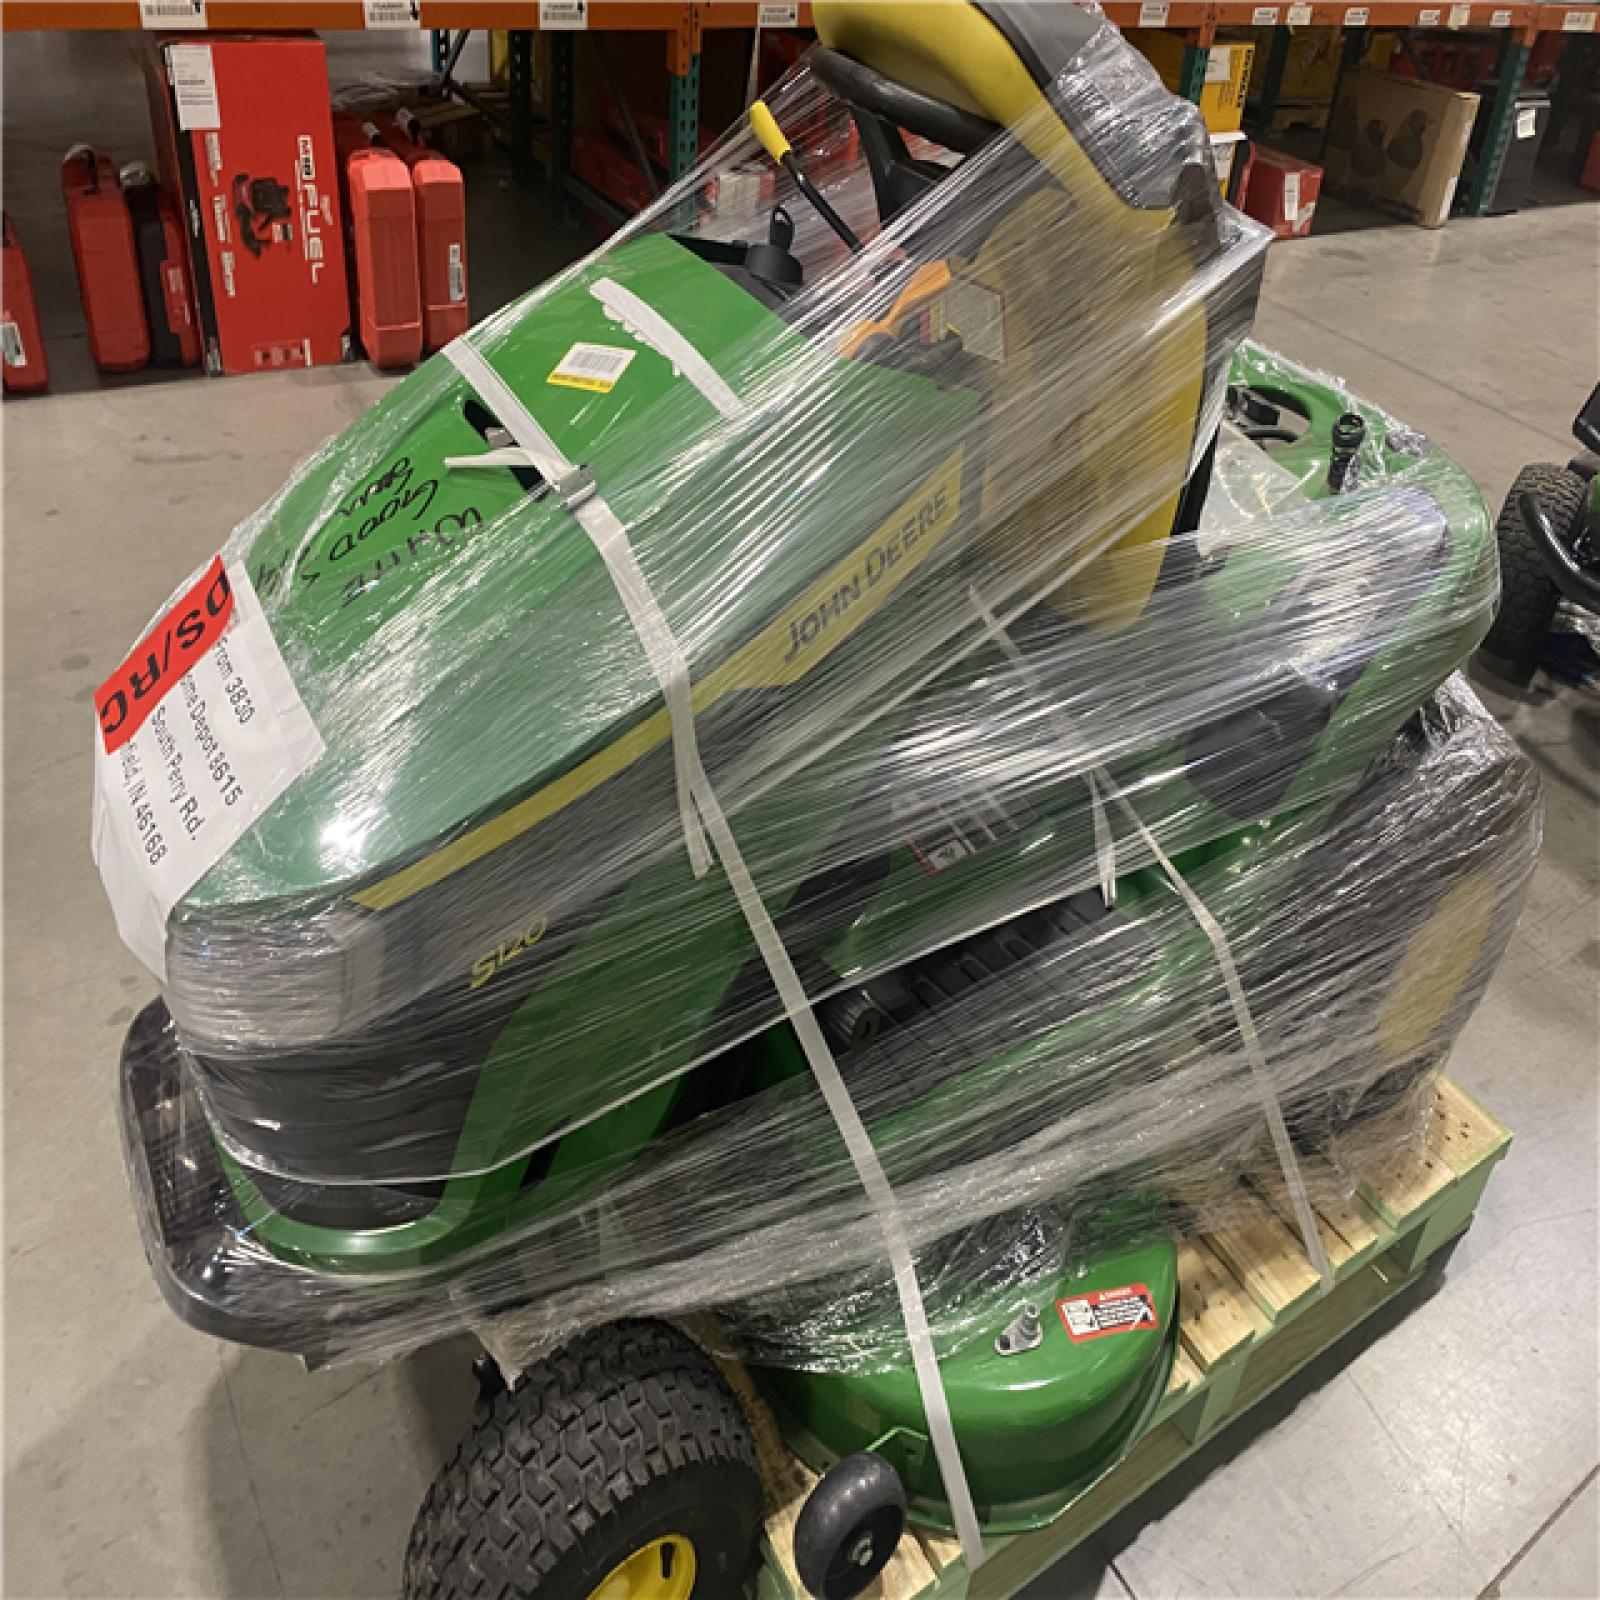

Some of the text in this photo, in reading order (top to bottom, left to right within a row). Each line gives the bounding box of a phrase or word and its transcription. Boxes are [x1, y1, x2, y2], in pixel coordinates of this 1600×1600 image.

[304, 184, 325, 285] FUEL
[784, 487, 947, 663] JOHN DEERE
[99, 569, 231, 734] DS/RC
[152, 705, 205, 840] South Perry Rd.
[190, 700, 219, 758] Depot
[127, 778, 147, 805] IN
[136, 802, 167, 865] 46168
